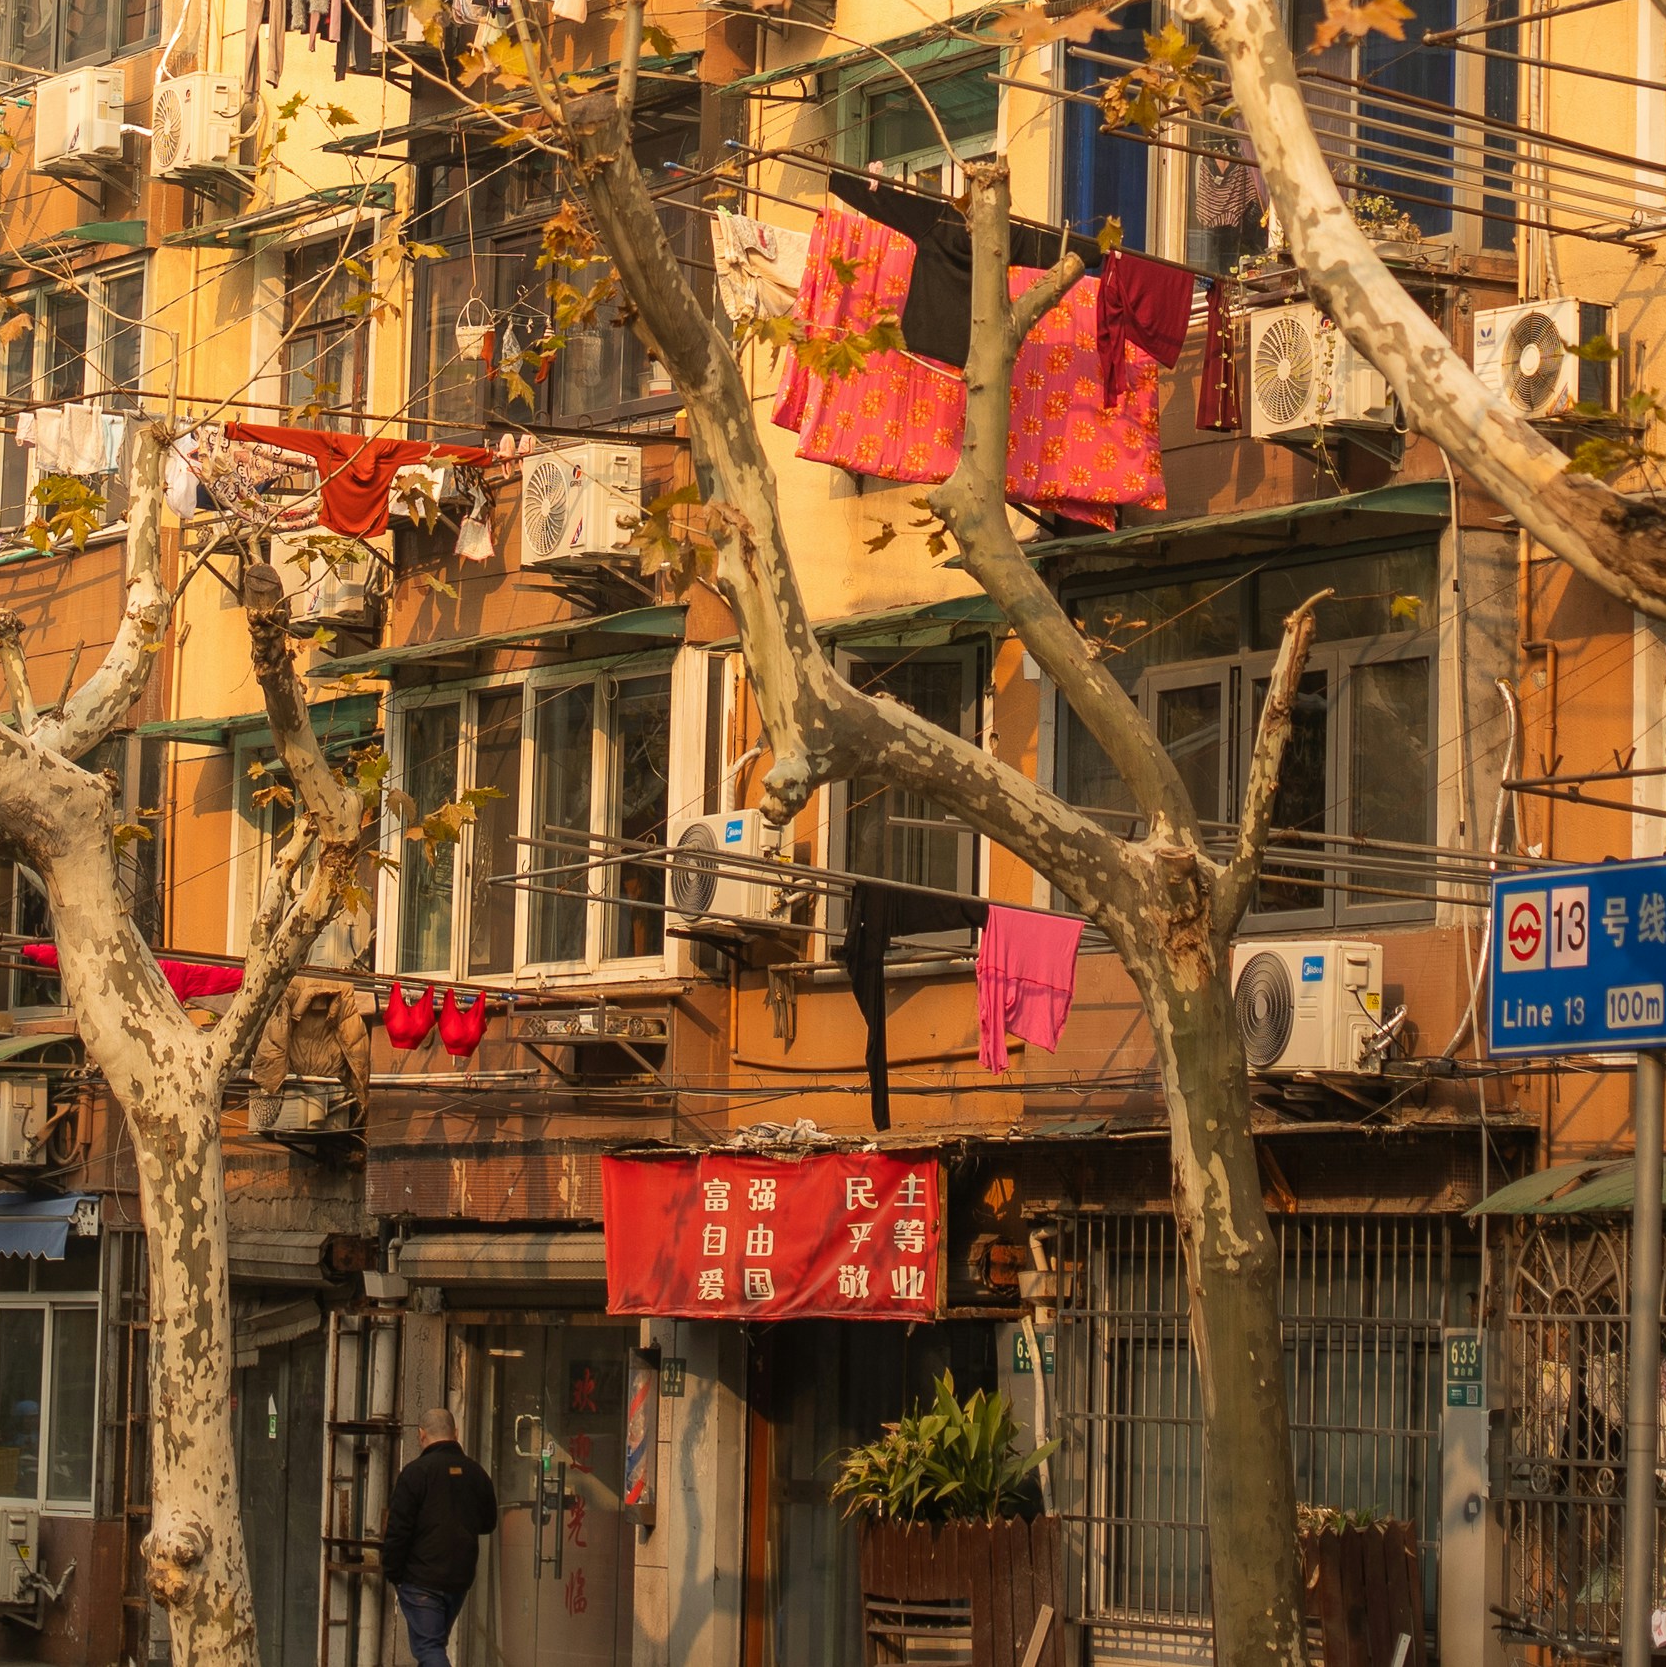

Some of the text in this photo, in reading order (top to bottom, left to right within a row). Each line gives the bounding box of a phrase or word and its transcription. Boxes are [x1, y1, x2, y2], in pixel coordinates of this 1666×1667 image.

[1553, 892, 1666, 952] 13 号线
[1502, 990, 1661, 1029] Line 13 100m
[664, 1362, 680, 1382] 631
[1451, 1341, 1476, 1364] 633
[565, 1367, 596, 1618] 欢迎光临
